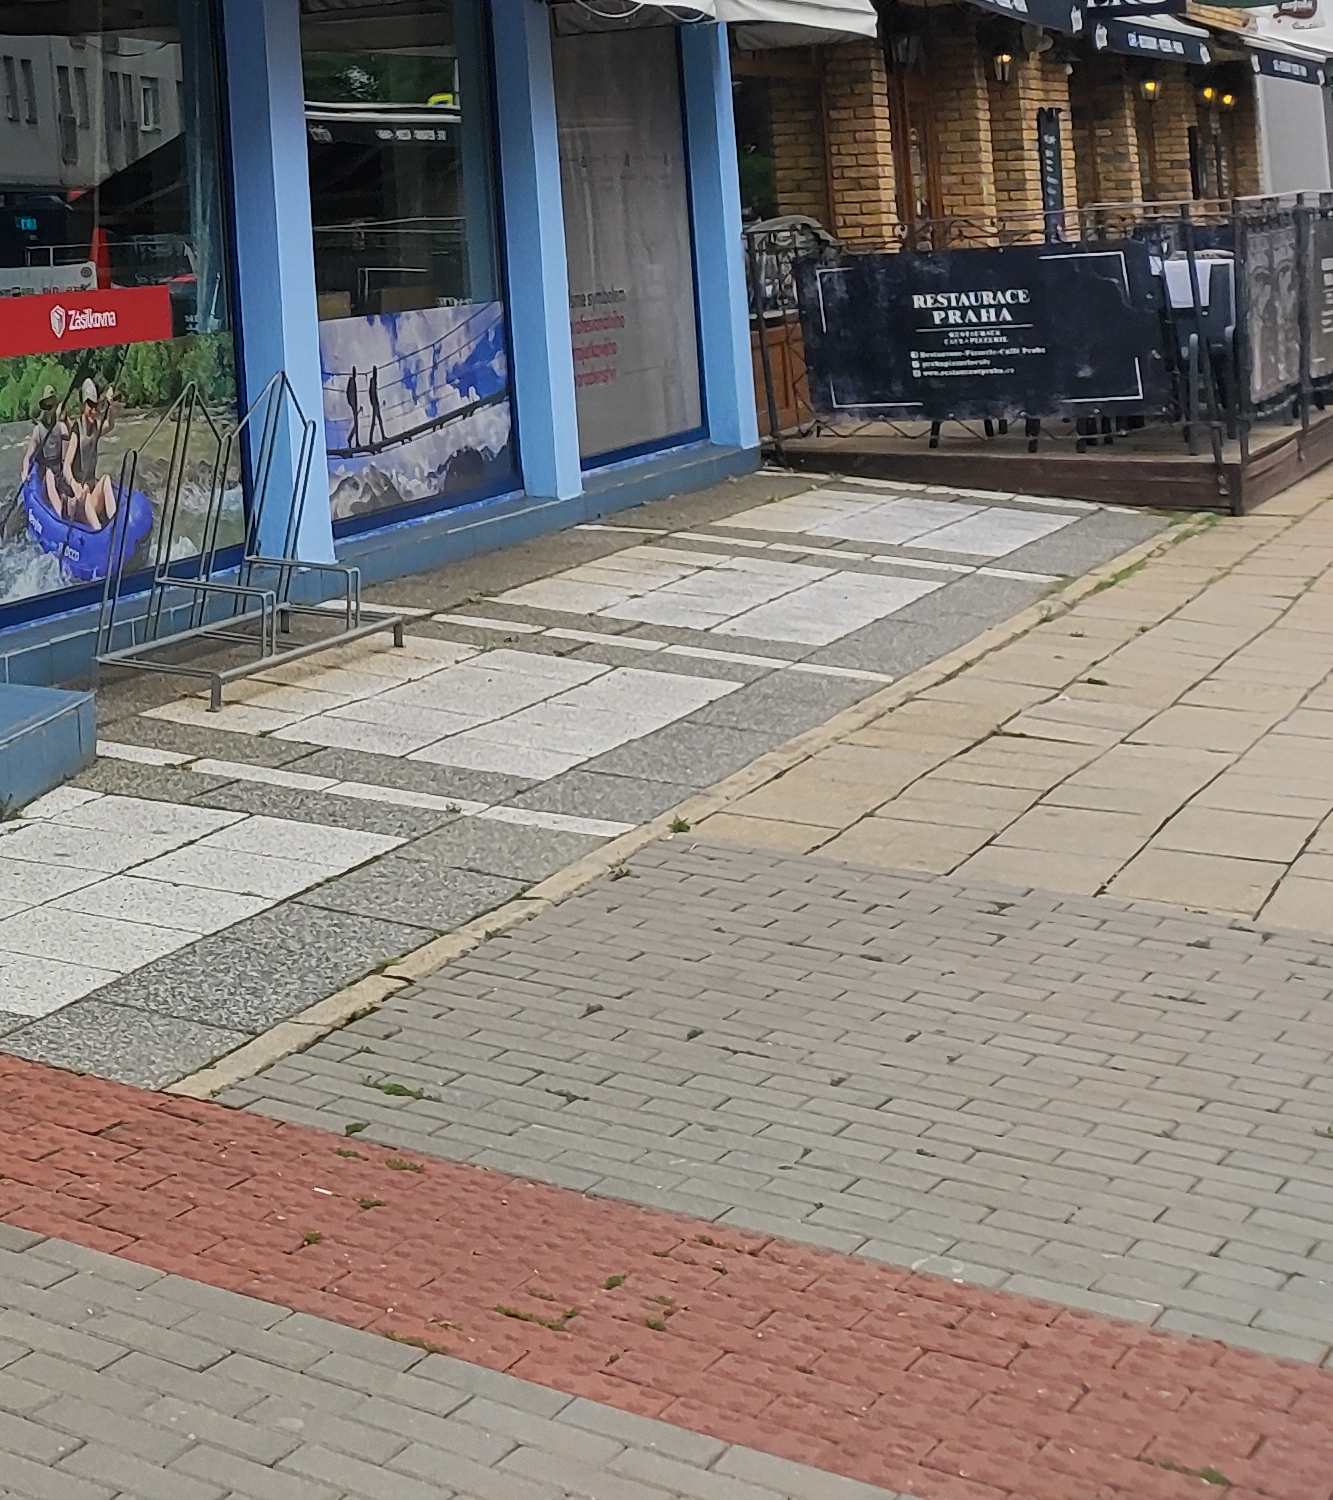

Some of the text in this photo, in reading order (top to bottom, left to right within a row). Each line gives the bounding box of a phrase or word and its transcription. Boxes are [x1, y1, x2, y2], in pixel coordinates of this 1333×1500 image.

[912, 289, 1031, 309] RESTAURACE
[68, 308, 117, 330] Zásilkovna
[932, 307, 1013, 325] PRAHA
